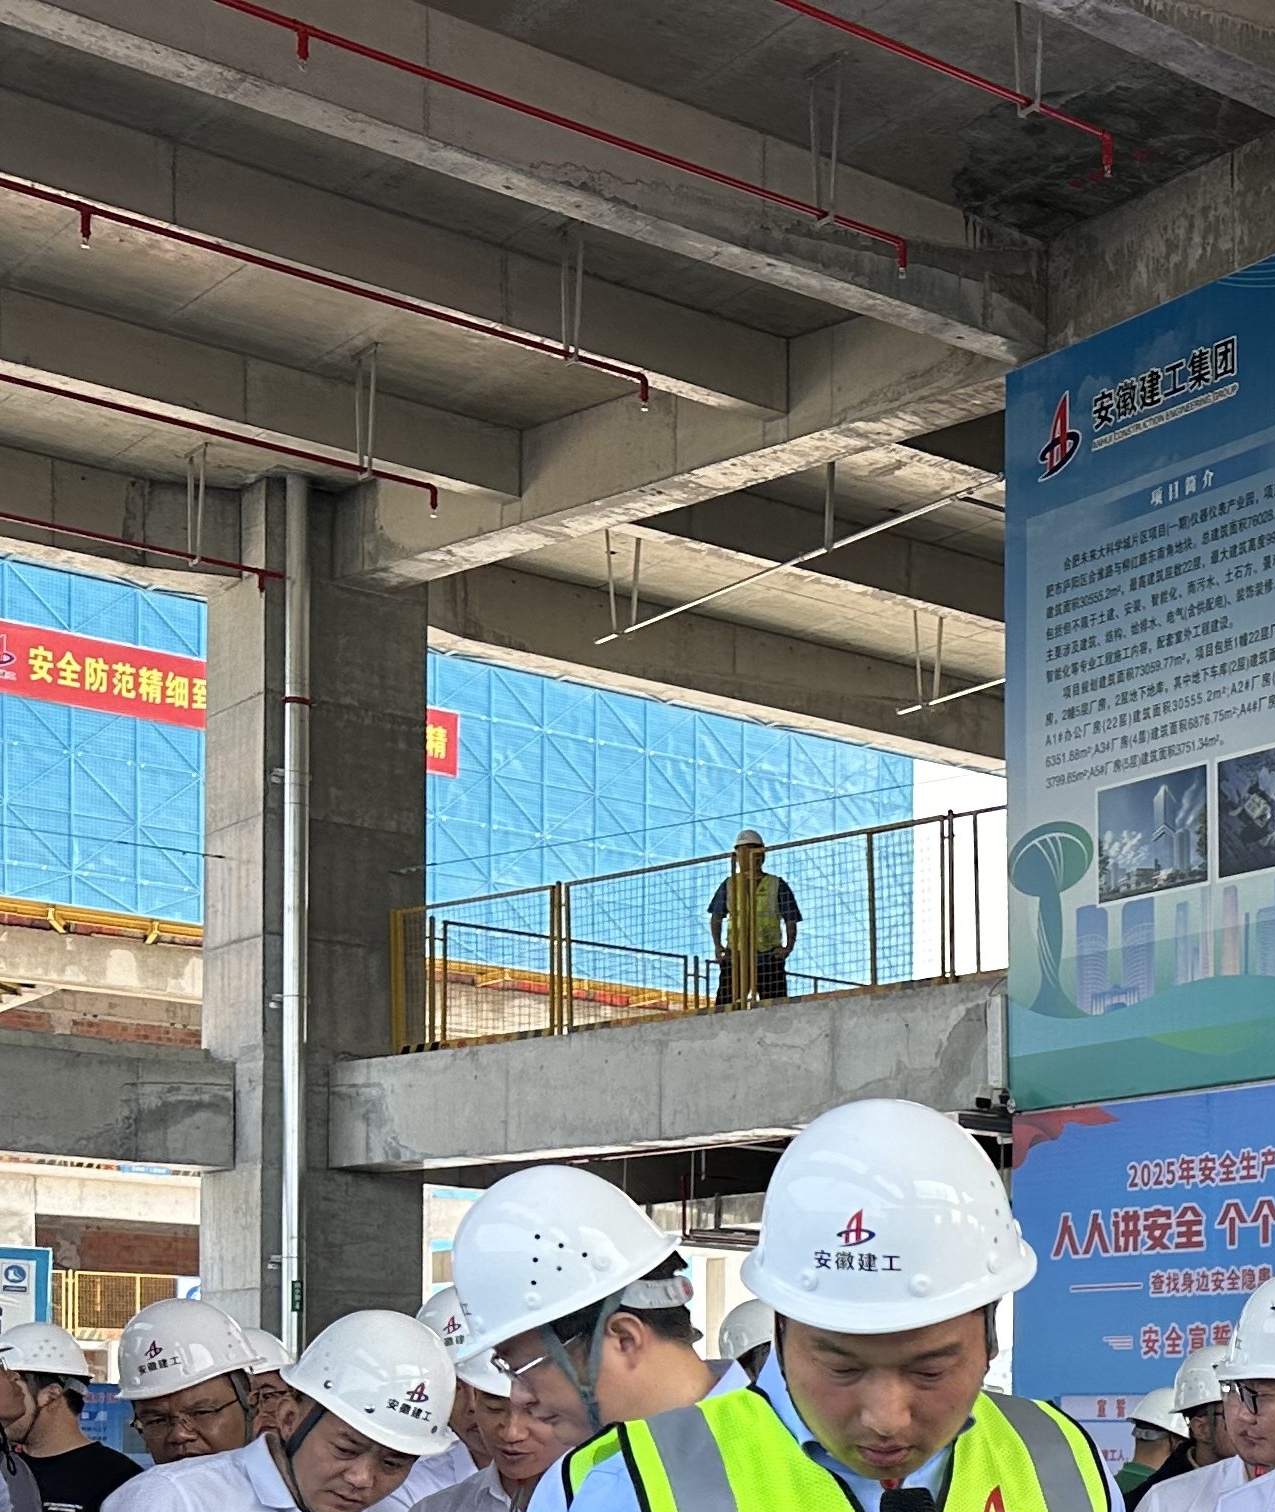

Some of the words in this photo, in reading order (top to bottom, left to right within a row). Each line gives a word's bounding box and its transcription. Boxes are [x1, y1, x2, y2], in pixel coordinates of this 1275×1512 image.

[1093, 335, 1237, 432] 安徽建工集团
[1151, 469, 1215, 505] 项目简介
[426, 725, 448, 761] 精
[1051, 1202, 1206, 1259] 人人讲安全
[814, 1250, 902, 1272] 安徽建工
[1149, 1266, 1273, 1297] 查找身边安全隐患
[138, 1355, 181, 1376] 安徽建工
[386, 1398, 431, 1423] 安徽建工
